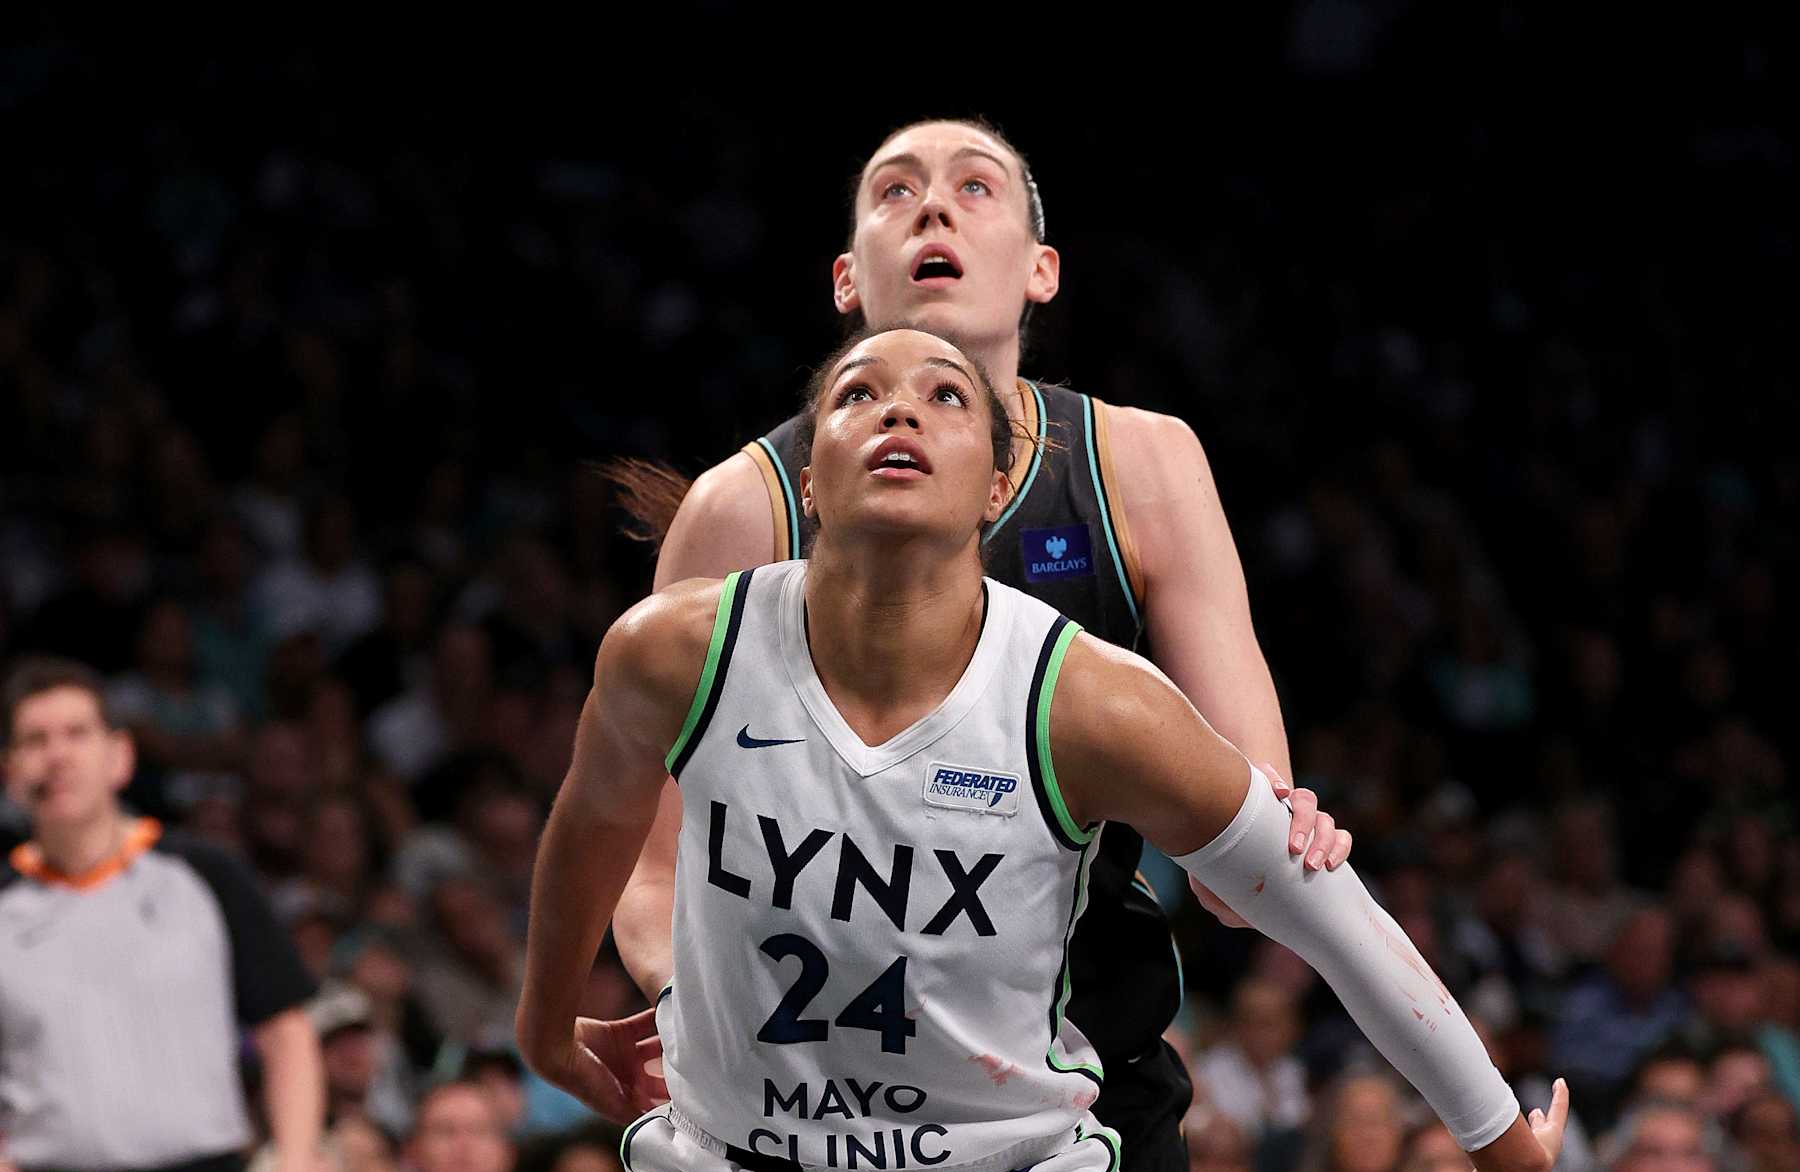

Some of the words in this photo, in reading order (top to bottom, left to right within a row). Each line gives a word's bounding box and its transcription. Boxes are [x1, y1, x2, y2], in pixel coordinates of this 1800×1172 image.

[1031, 557, 1088, 574] BARCLAYS
[929, 783, 987, 801] INSURANCE
[933, 768, 1018, 793] FEDERATED
[708, 800, 1005, 937] LYNX
[757, 933, 916, 1056] 24
[764, 1078, 928, 1121] MAYO
